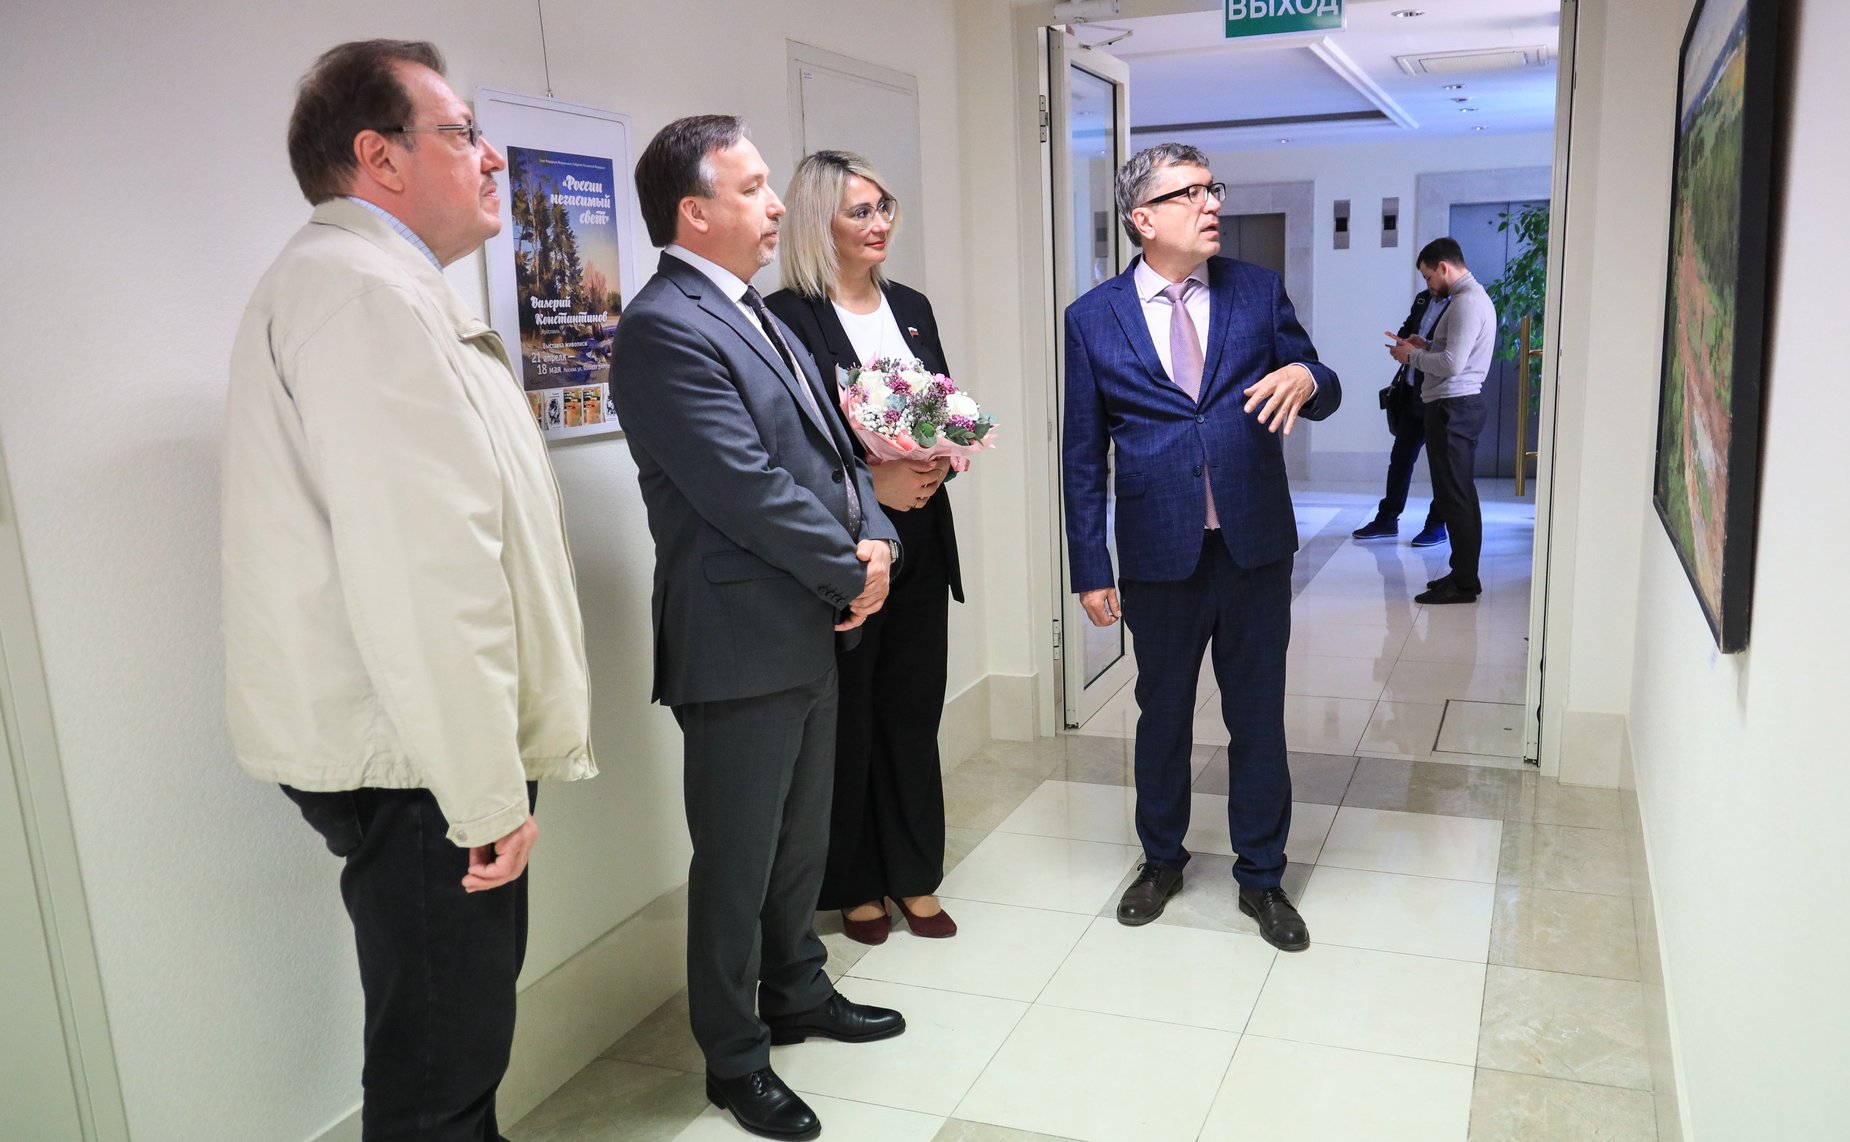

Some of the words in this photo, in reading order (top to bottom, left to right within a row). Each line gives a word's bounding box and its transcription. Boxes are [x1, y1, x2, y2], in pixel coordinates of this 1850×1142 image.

[1228, 0, 1339, 21] ВЫХОД
[562, 175, 603, 193] «России
[550, 193, 610, 208] негасимый
[531, 296, 571, 311] Валерий
[535, 311, 608, 325] Константинов
[532, 352, 541, 363] 21
[543, 355, 567, 364] апреля
[537, 364, 547, 375] 18
[549, 366, 561, 374] мая
